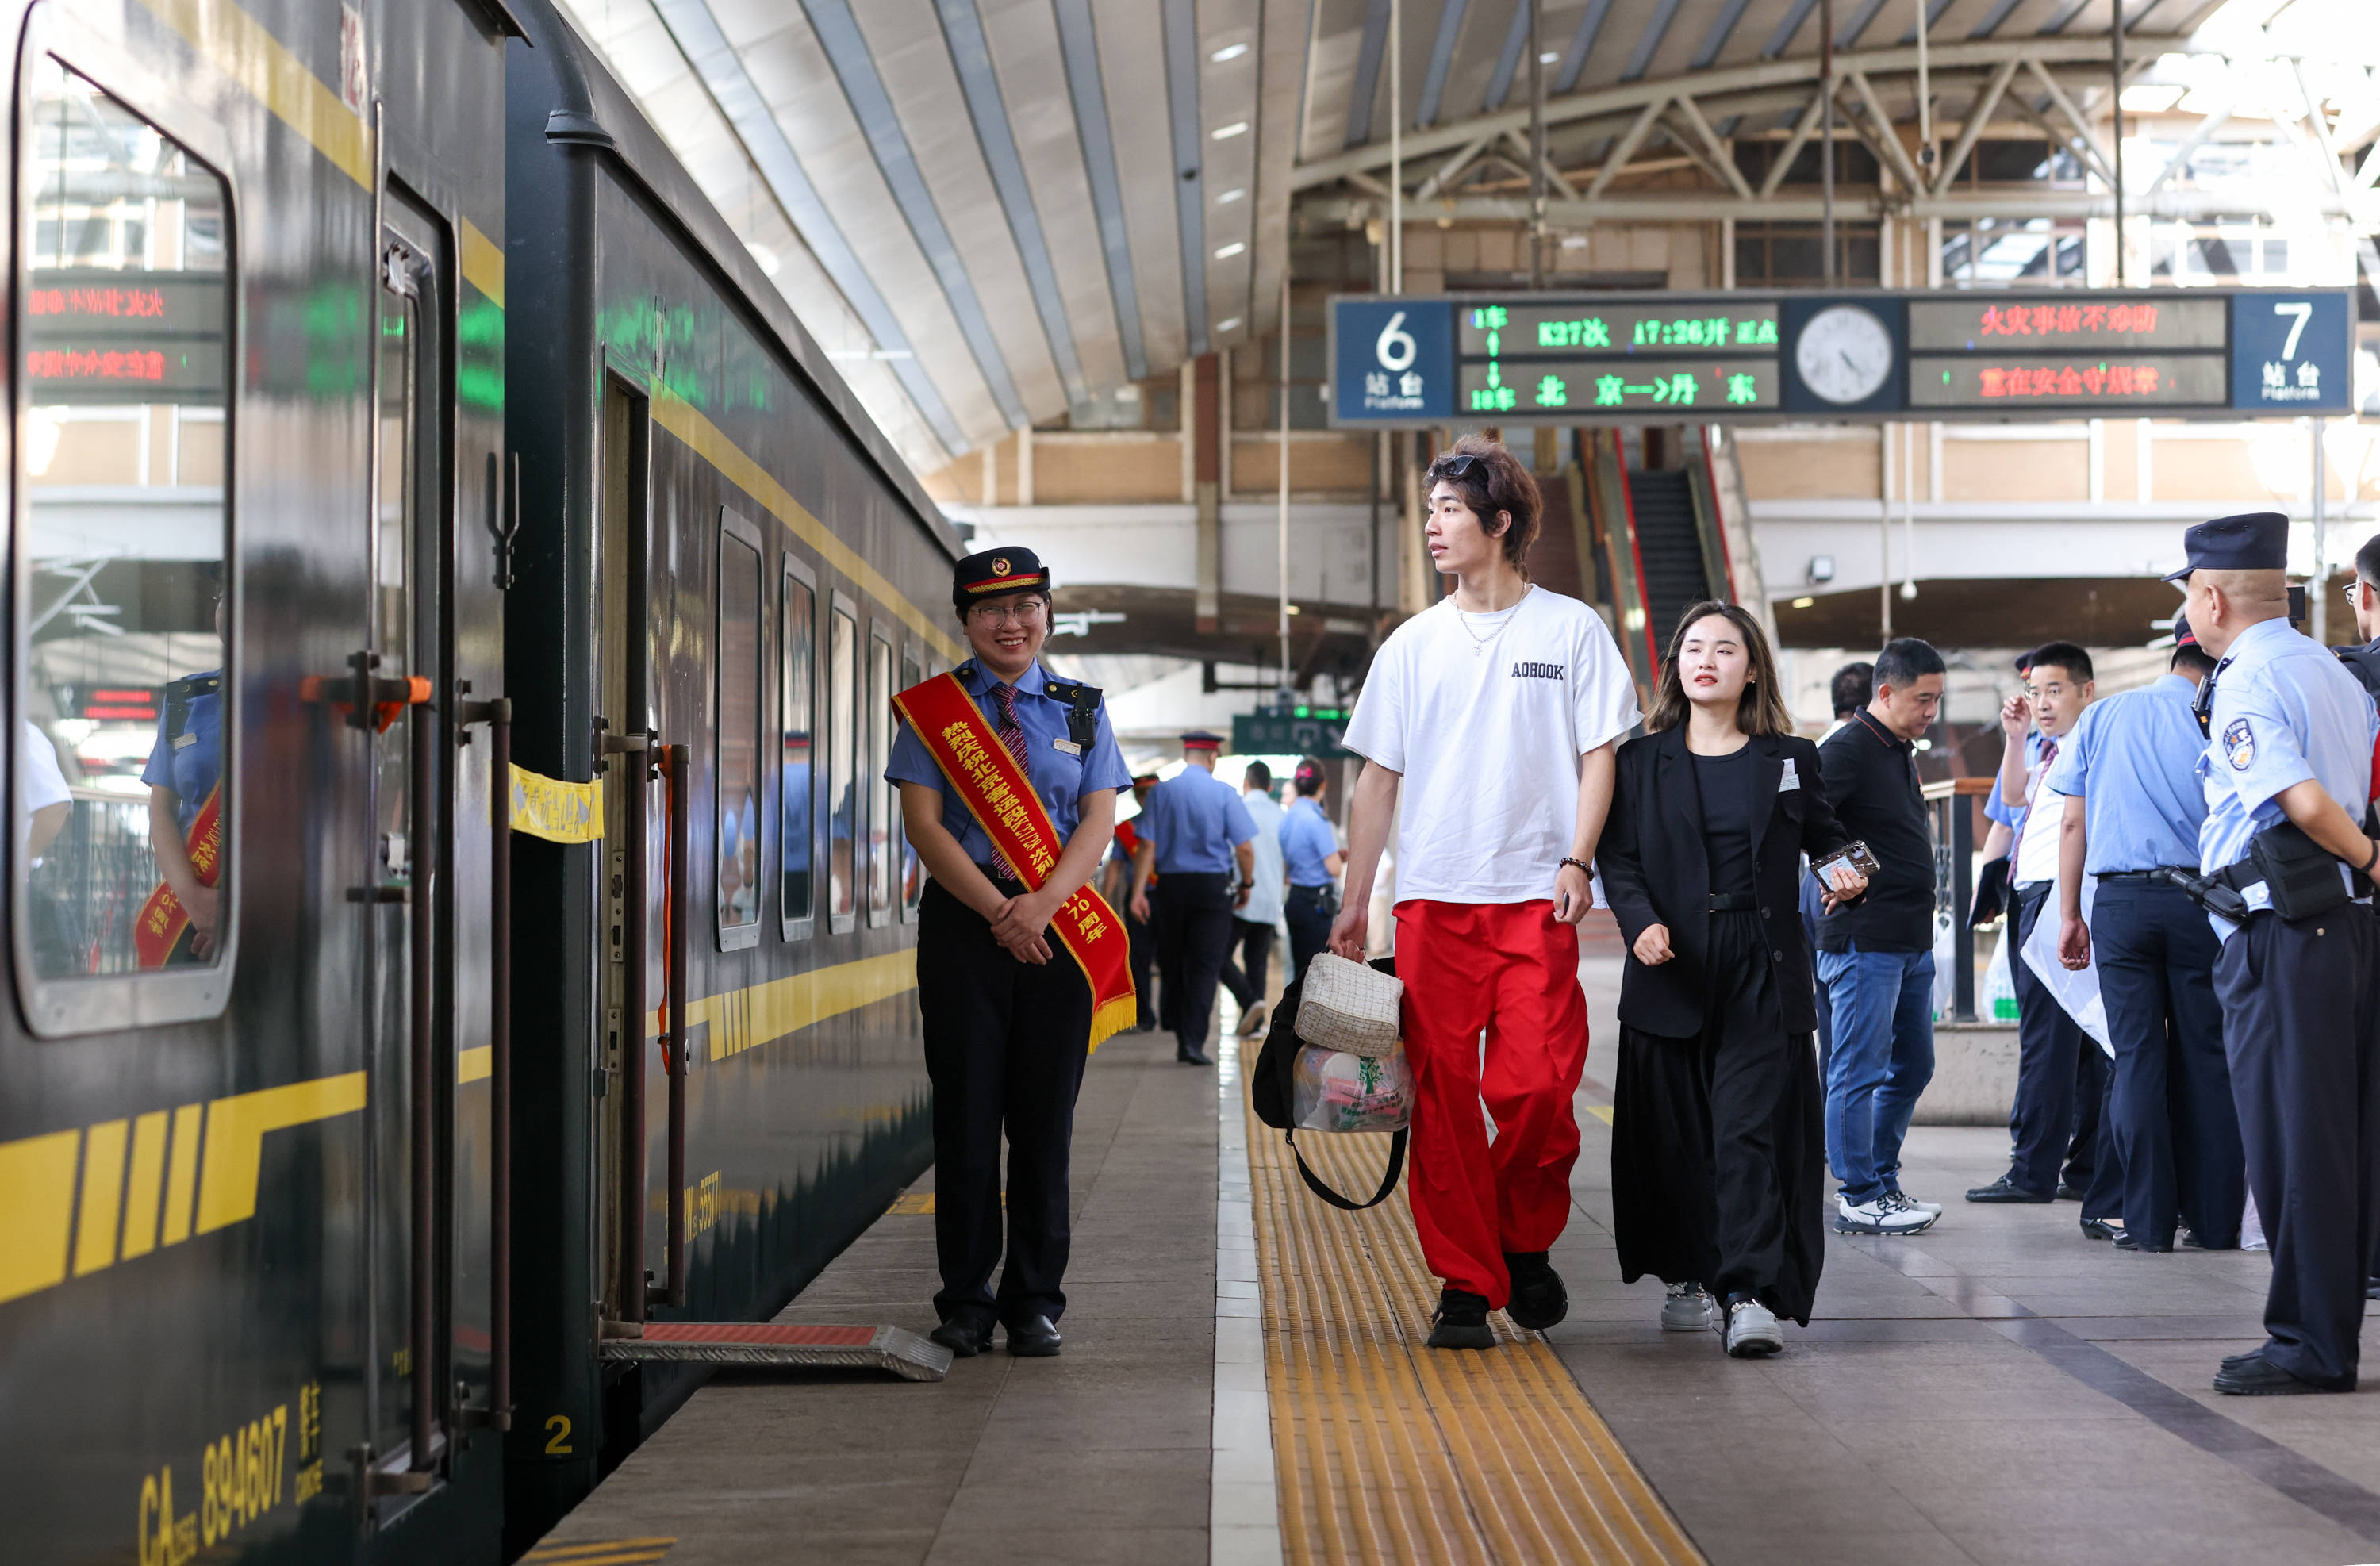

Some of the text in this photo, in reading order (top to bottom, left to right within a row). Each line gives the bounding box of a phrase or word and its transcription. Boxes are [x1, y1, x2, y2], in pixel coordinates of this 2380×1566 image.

[1376, 311, 1417, 371] 6
[1537, 317, 1611, 347] K27次
[2274, 302, 2313, 361] 7
[1365, 370, 1424, 396] 站台
[2262, 361, 2320, 387] 站台
[2261, 386, 2320, 401] Platform
[1511, 662, 1564, 681] AOHOOK
[545, 1414, 572, 1454] 2
[202, 1403, 288, 1549] 894607
